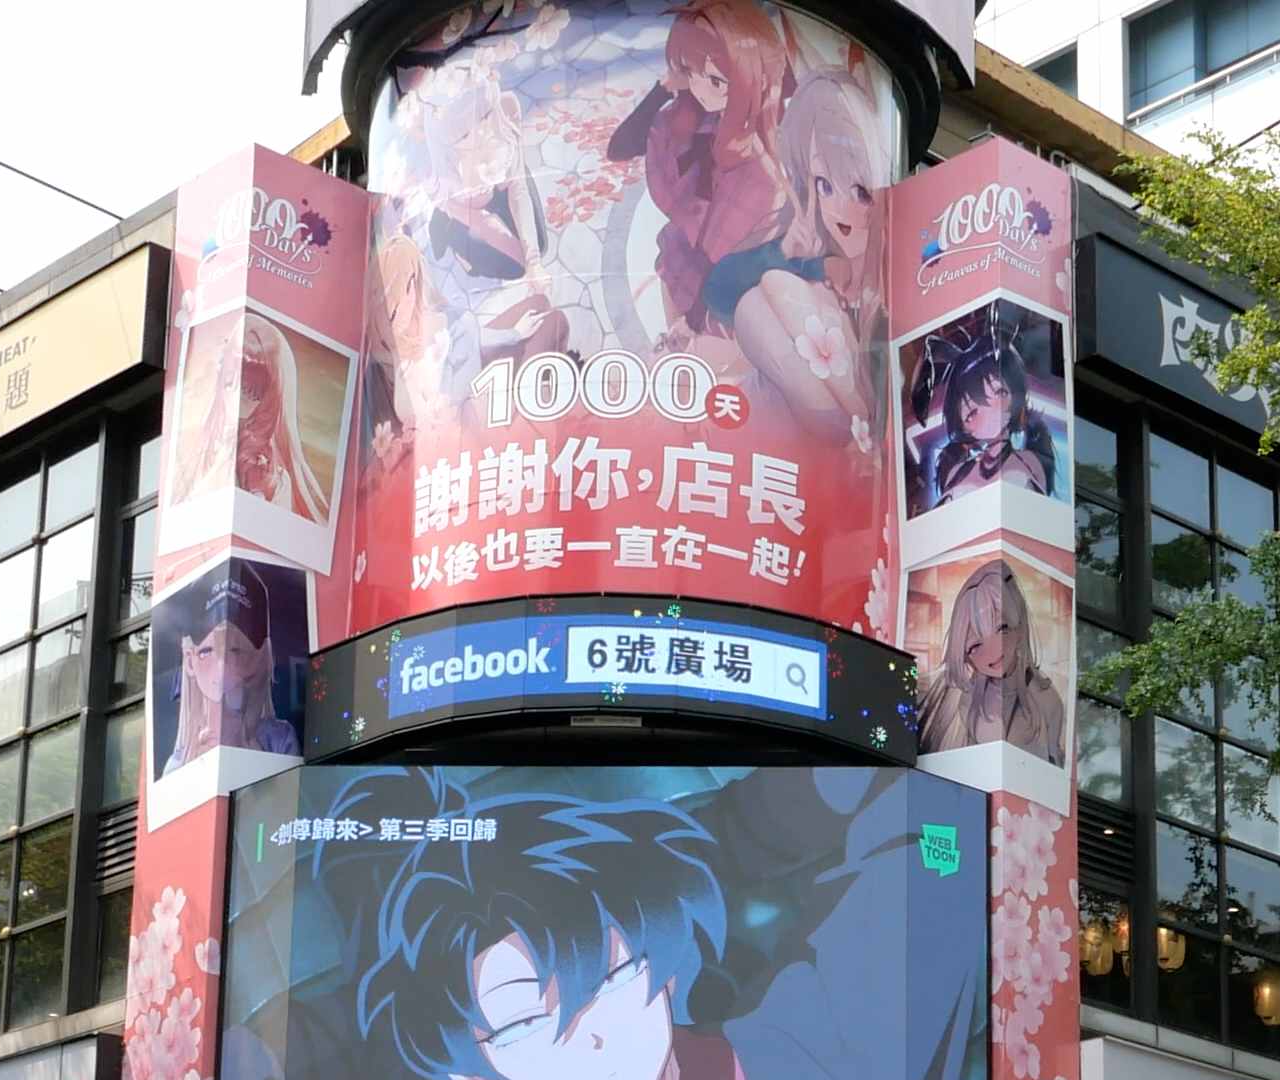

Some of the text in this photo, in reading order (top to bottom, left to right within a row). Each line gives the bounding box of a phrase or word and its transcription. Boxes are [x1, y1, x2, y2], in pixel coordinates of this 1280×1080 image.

[933, 182, 1033, 250] 1000
[471, 350, 742, 428] 1000 天
[401, 633, 753, 695] facebook 6號廣場
[379, 817, 499, 842] 第三季回歸
[927, 832, 952, 851] WEB
[925, 844, 957, 864] TOON
